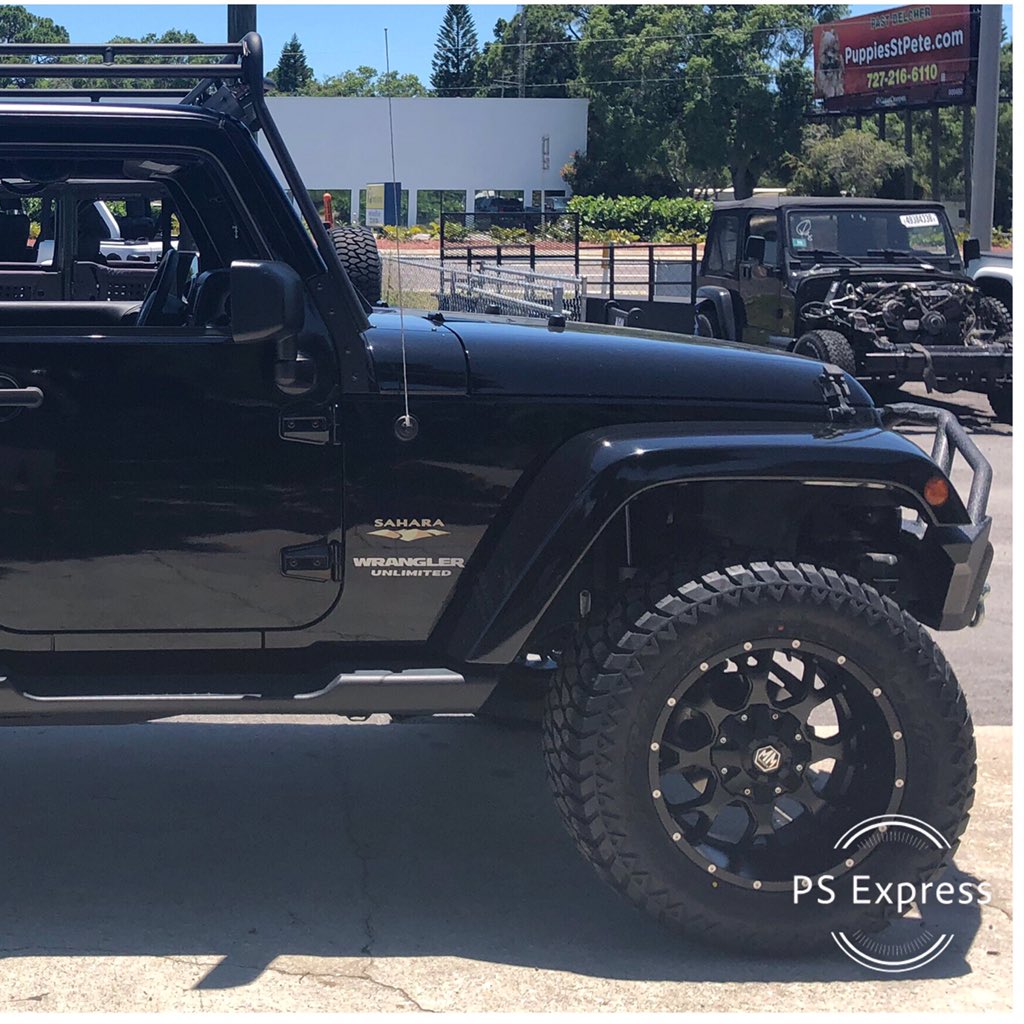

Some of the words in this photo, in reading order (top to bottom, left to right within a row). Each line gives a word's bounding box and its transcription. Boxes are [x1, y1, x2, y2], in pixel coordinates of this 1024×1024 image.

[844, 29, 964, 65] PuppiesStPete.com
[866, 63, 938, 88] 727-216-6110
[374, 518, 445, 528] SAHARA
[353, 557, 465, 568] WRANGLER
[371, 569, 452, 577] UNLIMITED
